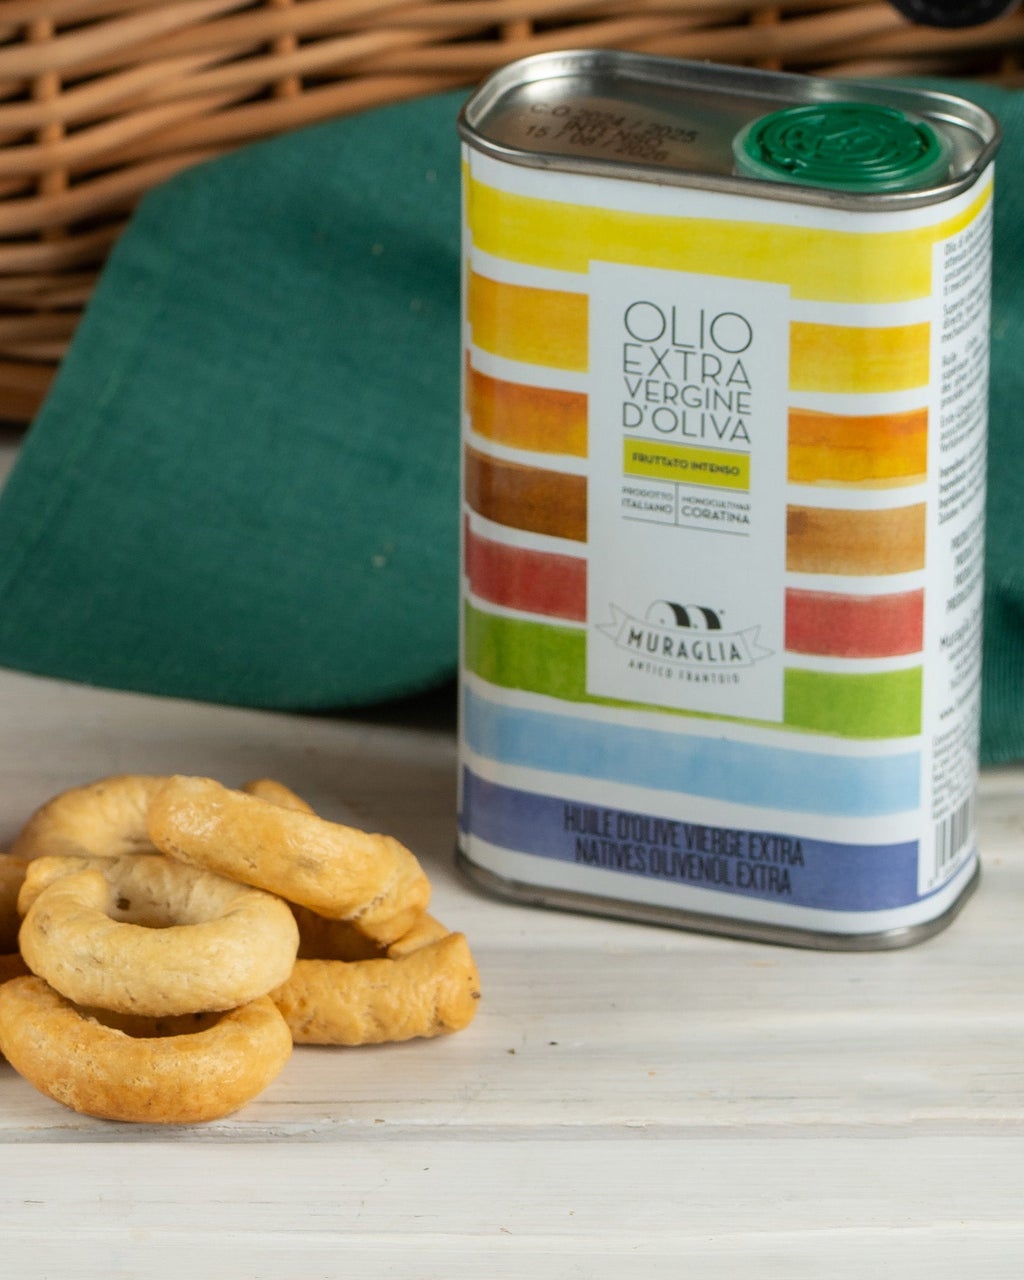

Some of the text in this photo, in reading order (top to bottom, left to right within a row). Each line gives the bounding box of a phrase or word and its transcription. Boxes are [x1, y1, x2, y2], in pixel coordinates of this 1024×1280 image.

[624, 300, 753, 354] OLIO
[623, 342, 752, 390] EXTRA
[624, 376, 752, 415] VERGINE
[622, 402, 751, 444] D'OLIVA
[632, 451, 740, 476] FRUTTATO INTENSO
[622, 486, 674, 501] PRODOTTO
[622, 497, 673, 515] ITALIANO
[681, 505, 751, 524] CORATINA
[627, 626, 743, 662] MURAGLIA
[628, 659, 674, 680] ANTICO
[563, 803, 613, 839] HUILE
[683, 822, 744, 859] VIERGE
[748, 832, 805, 868] EXTRA
[574, 837, 647, 873] NATIVES
[736, 859, 793, 895] EXTRA
